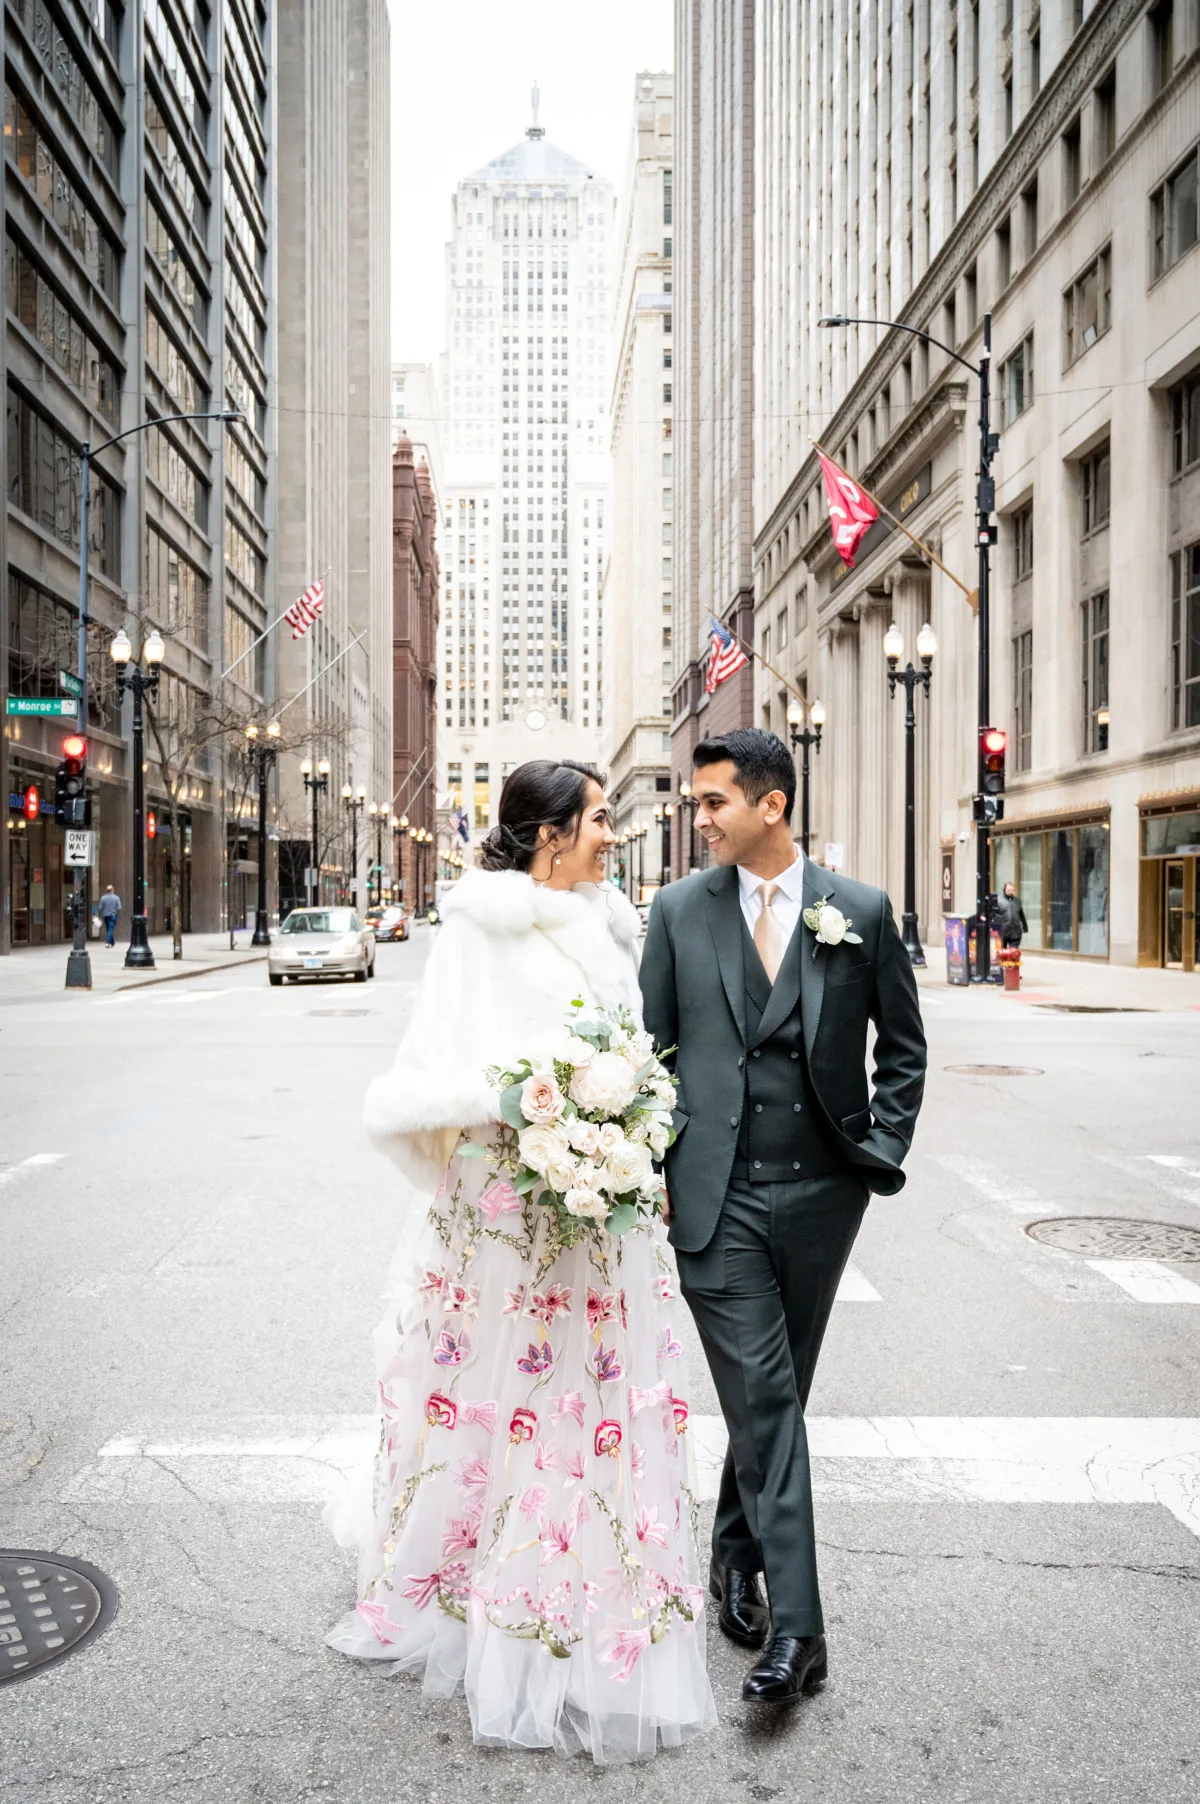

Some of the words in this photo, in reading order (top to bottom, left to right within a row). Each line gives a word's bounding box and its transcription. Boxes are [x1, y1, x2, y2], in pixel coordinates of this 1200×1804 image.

[18, 701, 52, 712] Monroe
[69, 833, 87, 842] ONE
[69, 844, 87, 852] WAY
